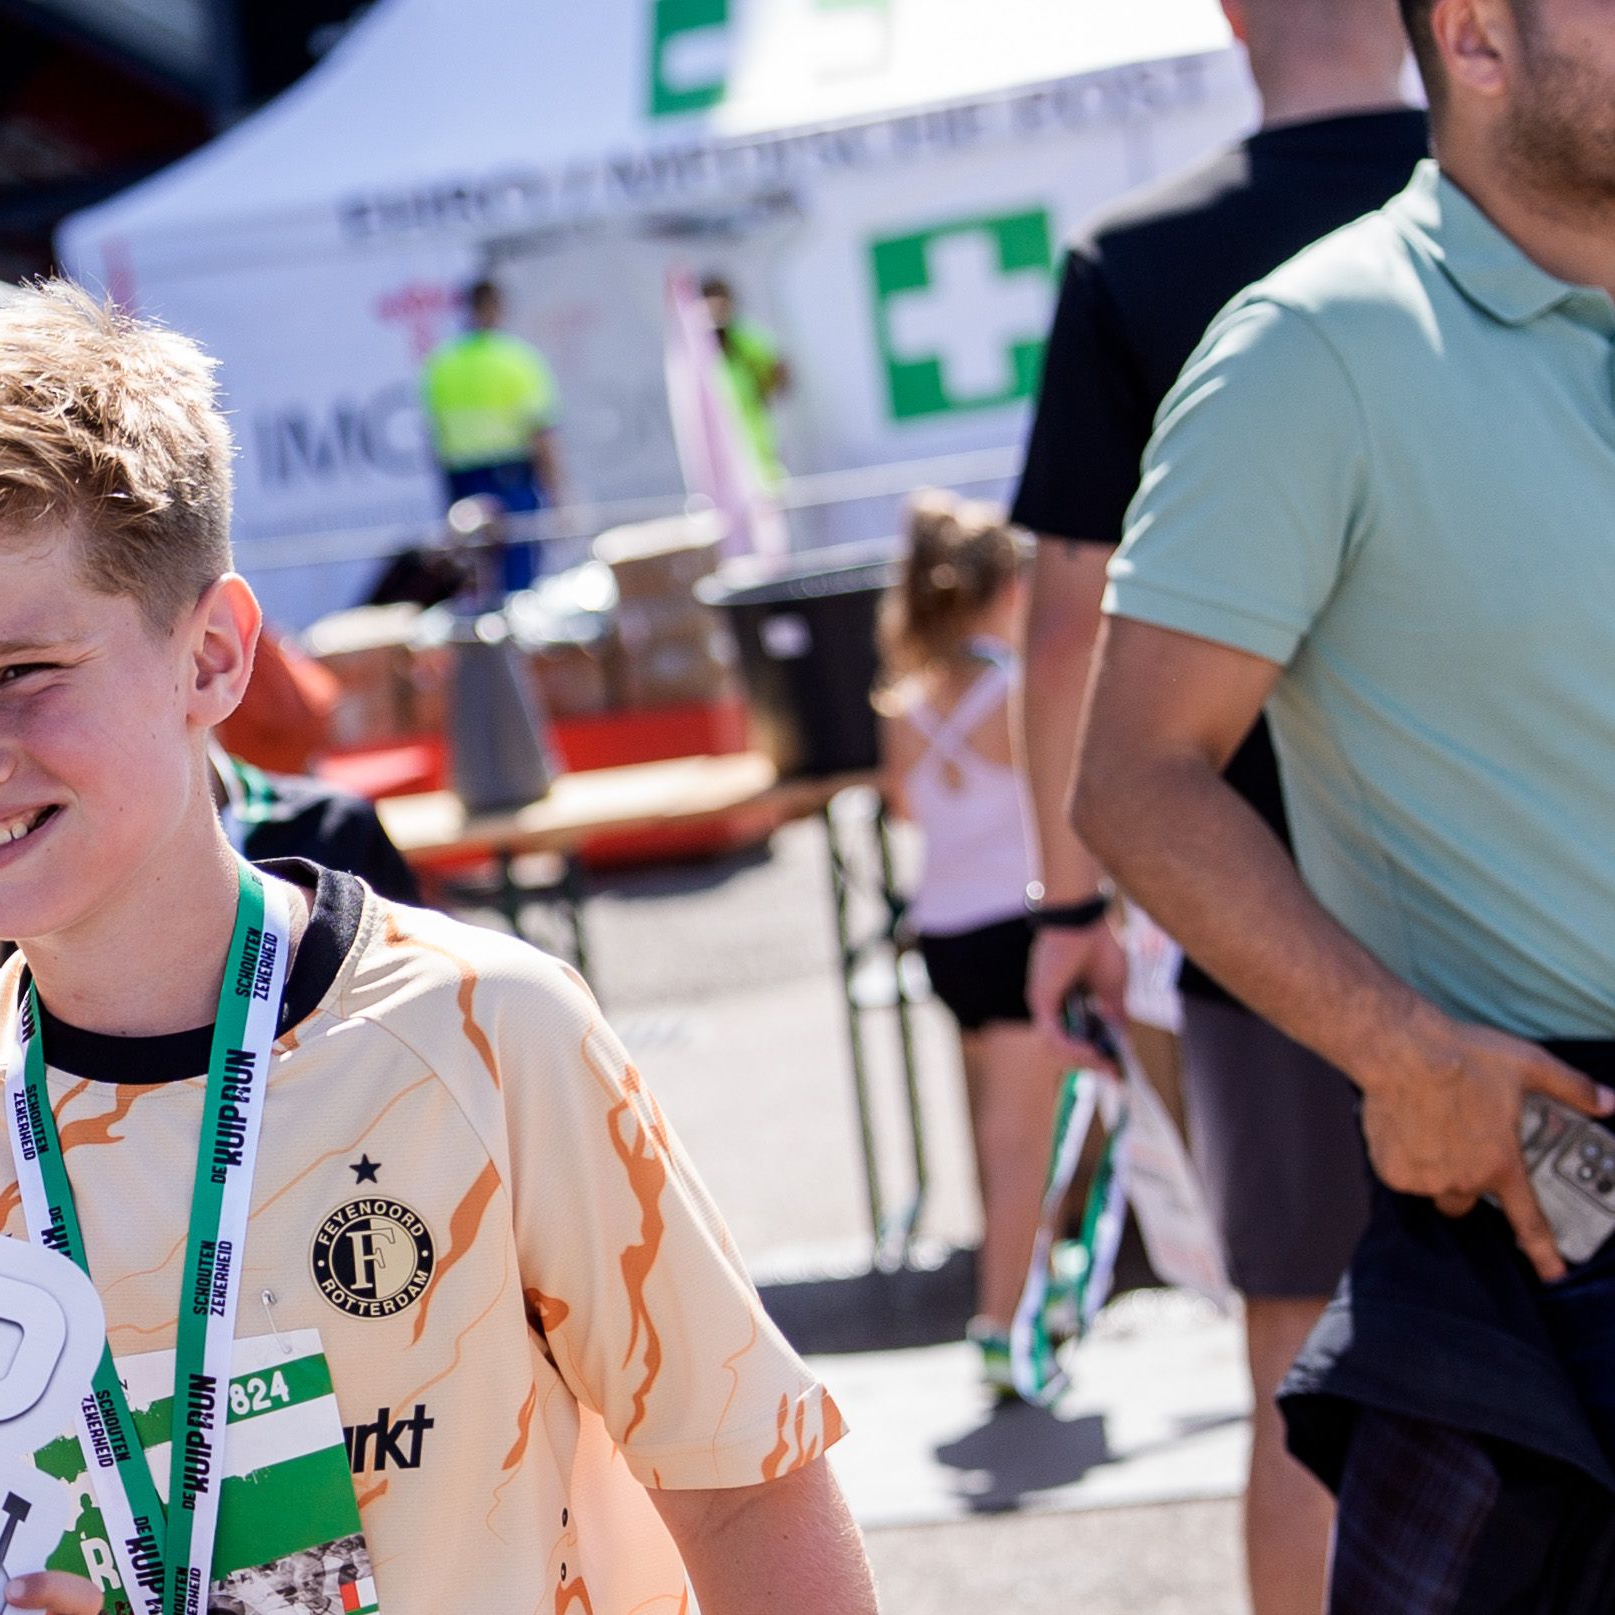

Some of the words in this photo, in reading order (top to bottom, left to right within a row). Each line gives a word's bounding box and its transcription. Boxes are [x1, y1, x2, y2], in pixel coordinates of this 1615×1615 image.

[235, 926, 262, 998] SCHOUTEN
[252, 931, 278, 1001] ZEKERHEID
[13, 1089, 36, 1161] ZEKERHEID
[26, 1084, 49, 1154] SCHOUTEN
[211, 1165, 228, 1185] DE
[318, 1200, 424, 1246] FEYENOORD
[193, 1240, 216, 1316] SCHOUTEN
[210, 1240, 233, 1317] ZEKERHEID
[321, 1268, 429, 1317] ROTTERDAM
[346, 1228, 396, 1290] F
[81, 1394, 114, 1468] ZEKERHEID
[96, 1390, 131, 1463] SCHOUTEN
[133, 1516, 152, 1536] DE
[182, 1491, 197, 1511] DE
